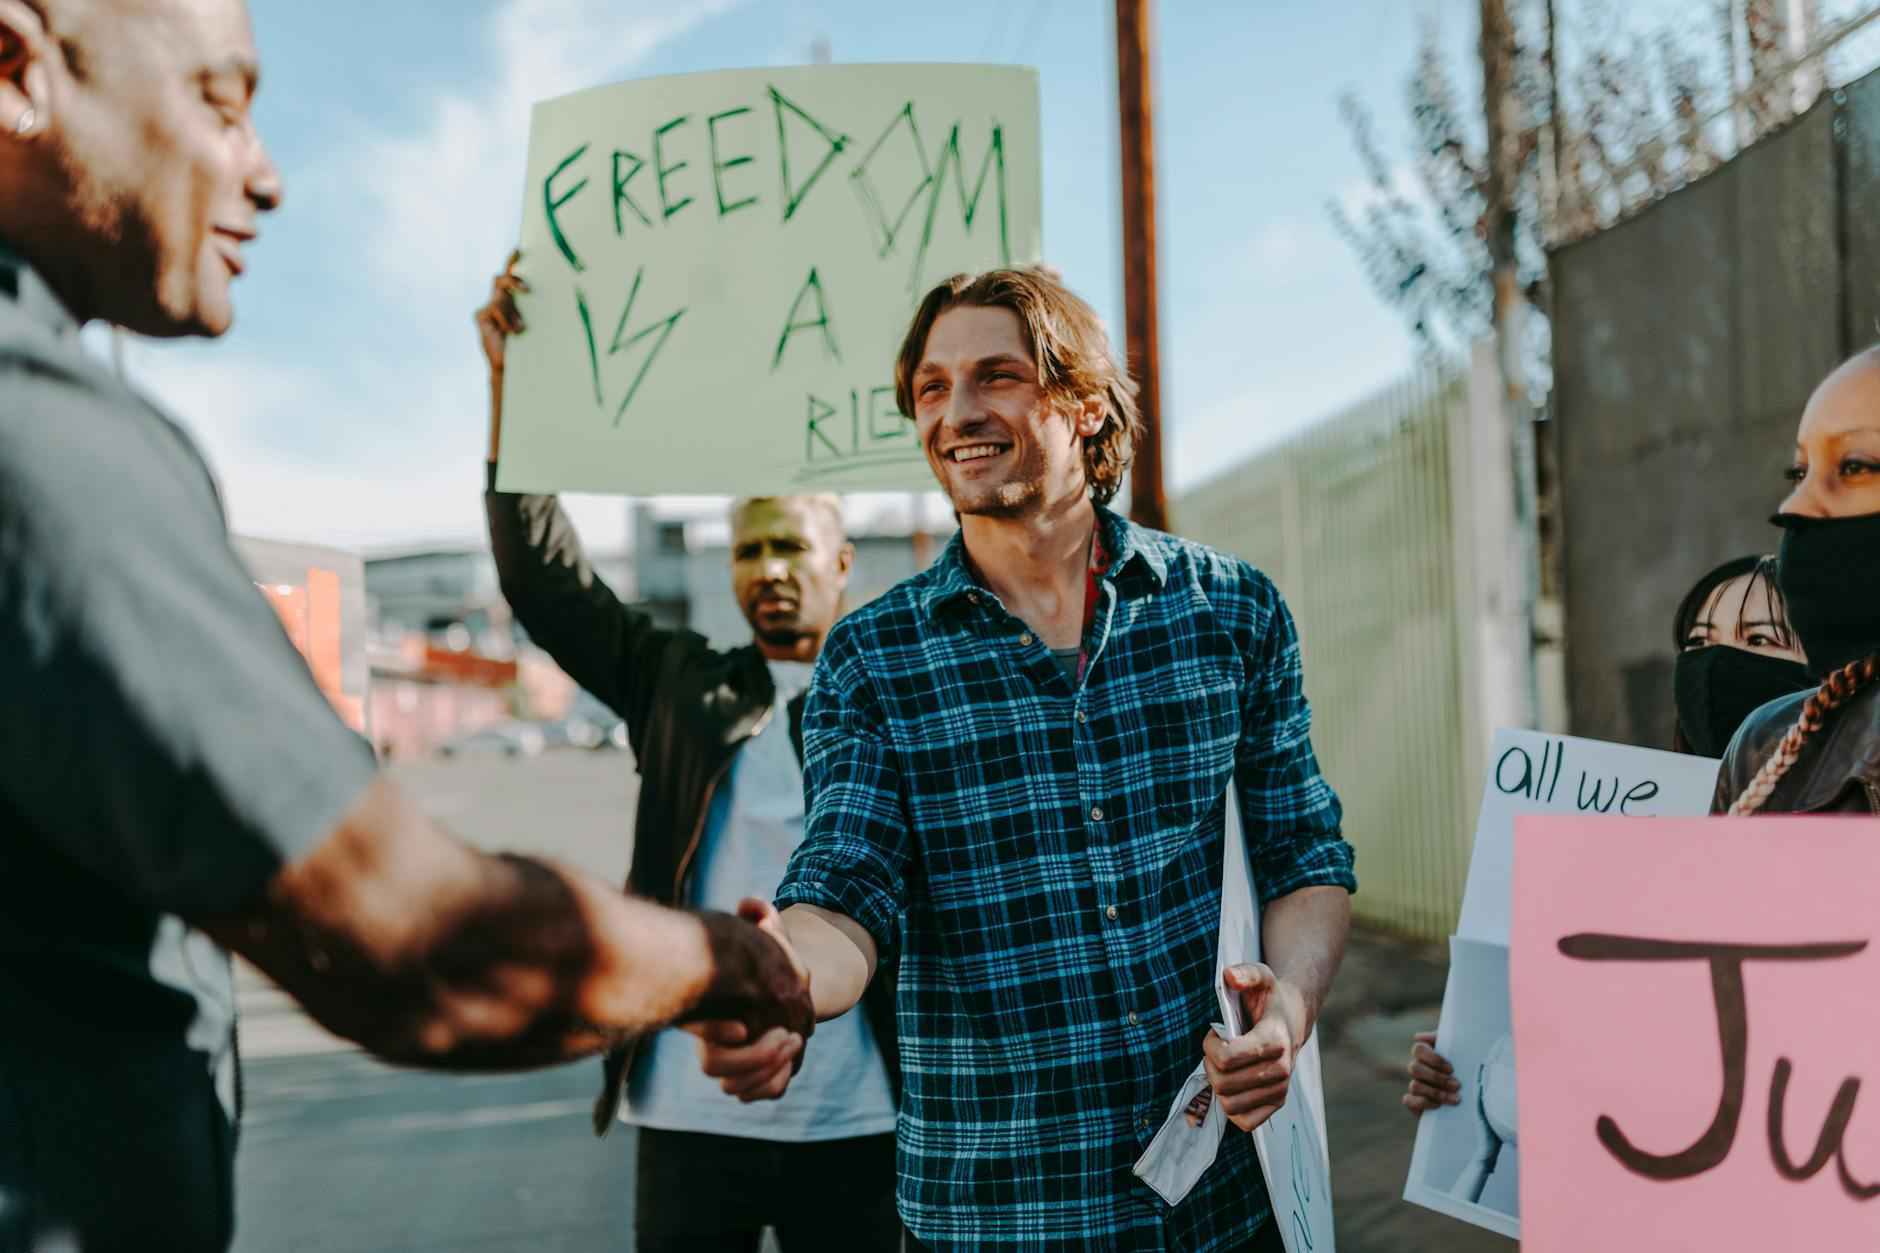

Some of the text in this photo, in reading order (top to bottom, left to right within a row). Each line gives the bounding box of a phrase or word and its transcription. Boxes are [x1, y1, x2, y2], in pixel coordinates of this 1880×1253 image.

[543, 83, 1012, 305] FREEDOM
[770, 266, 843, 375] A
[805, 386, 922, 461] RIG
[1495, 740, 1659, 818] all we
